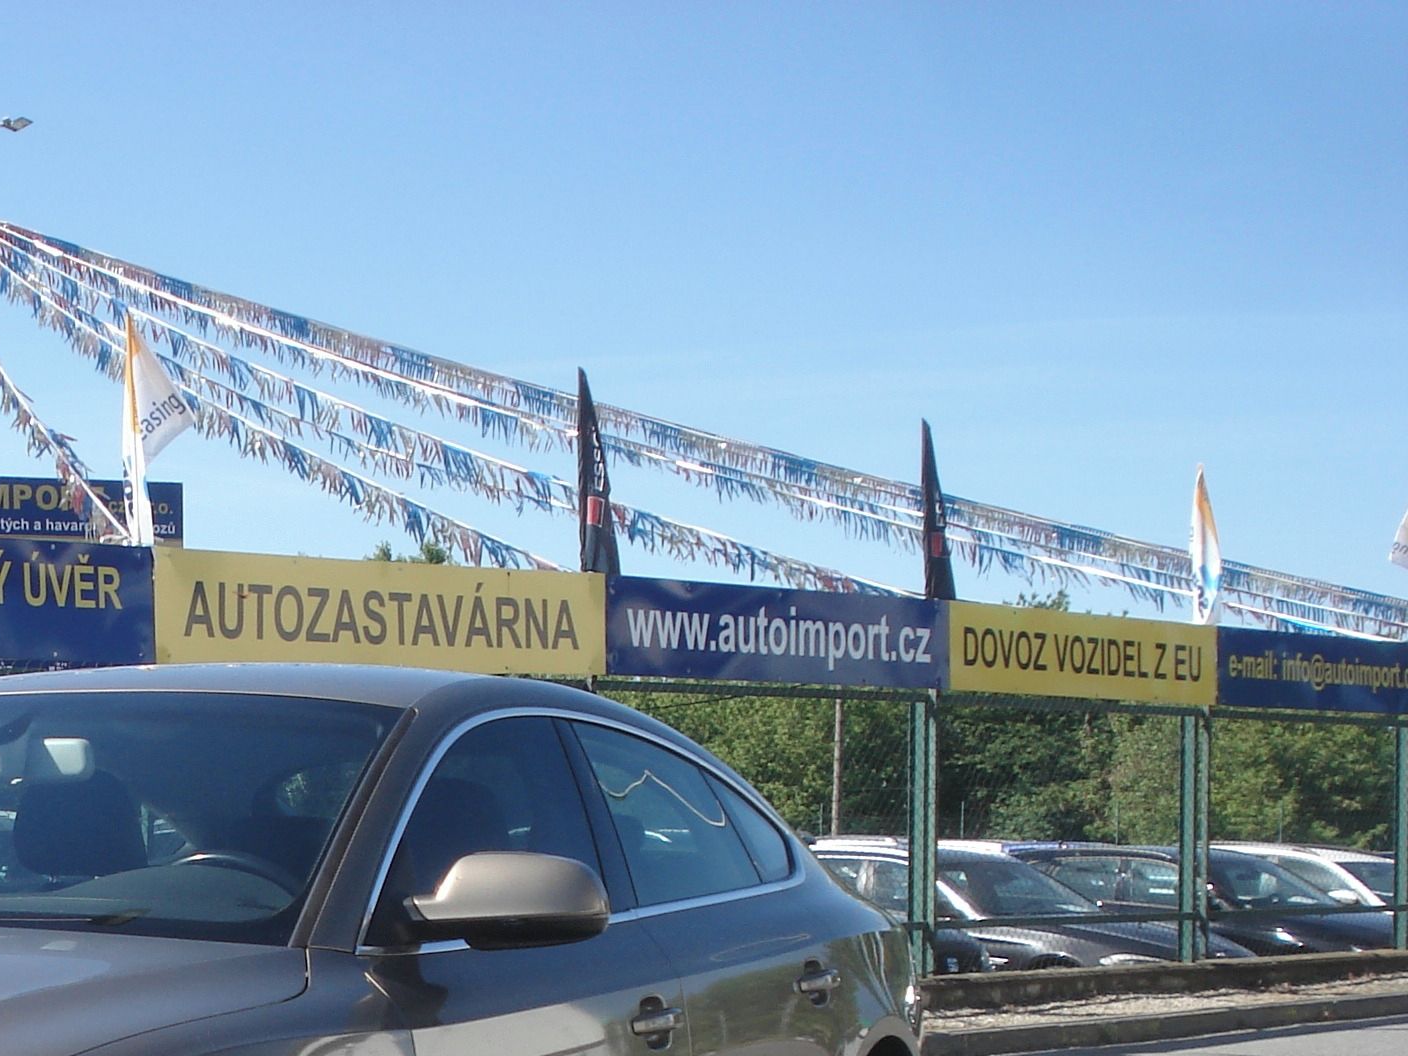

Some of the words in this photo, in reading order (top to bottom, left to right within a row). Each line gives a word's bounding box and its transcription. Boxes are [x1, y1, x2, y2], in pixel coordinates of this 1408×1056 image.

[140, 392, 187, 441] asing
[33, 521, 41, 531] a
[22, 553, 123, 610] ÚVĚR
[183, 580, 580, 651] AUTOZASTAVÁRNA
[626, 605, 931, 672] www.autoimport.cz
[963, 626, 1047, 672] DOVOZ
[1053, 633, 1148, 679] VOZIDEL
[1154, 642, 1168, 680] Z
[1174, 644, 1202, 683] EU
[1228, 651, 1278, 681] e-mail:
